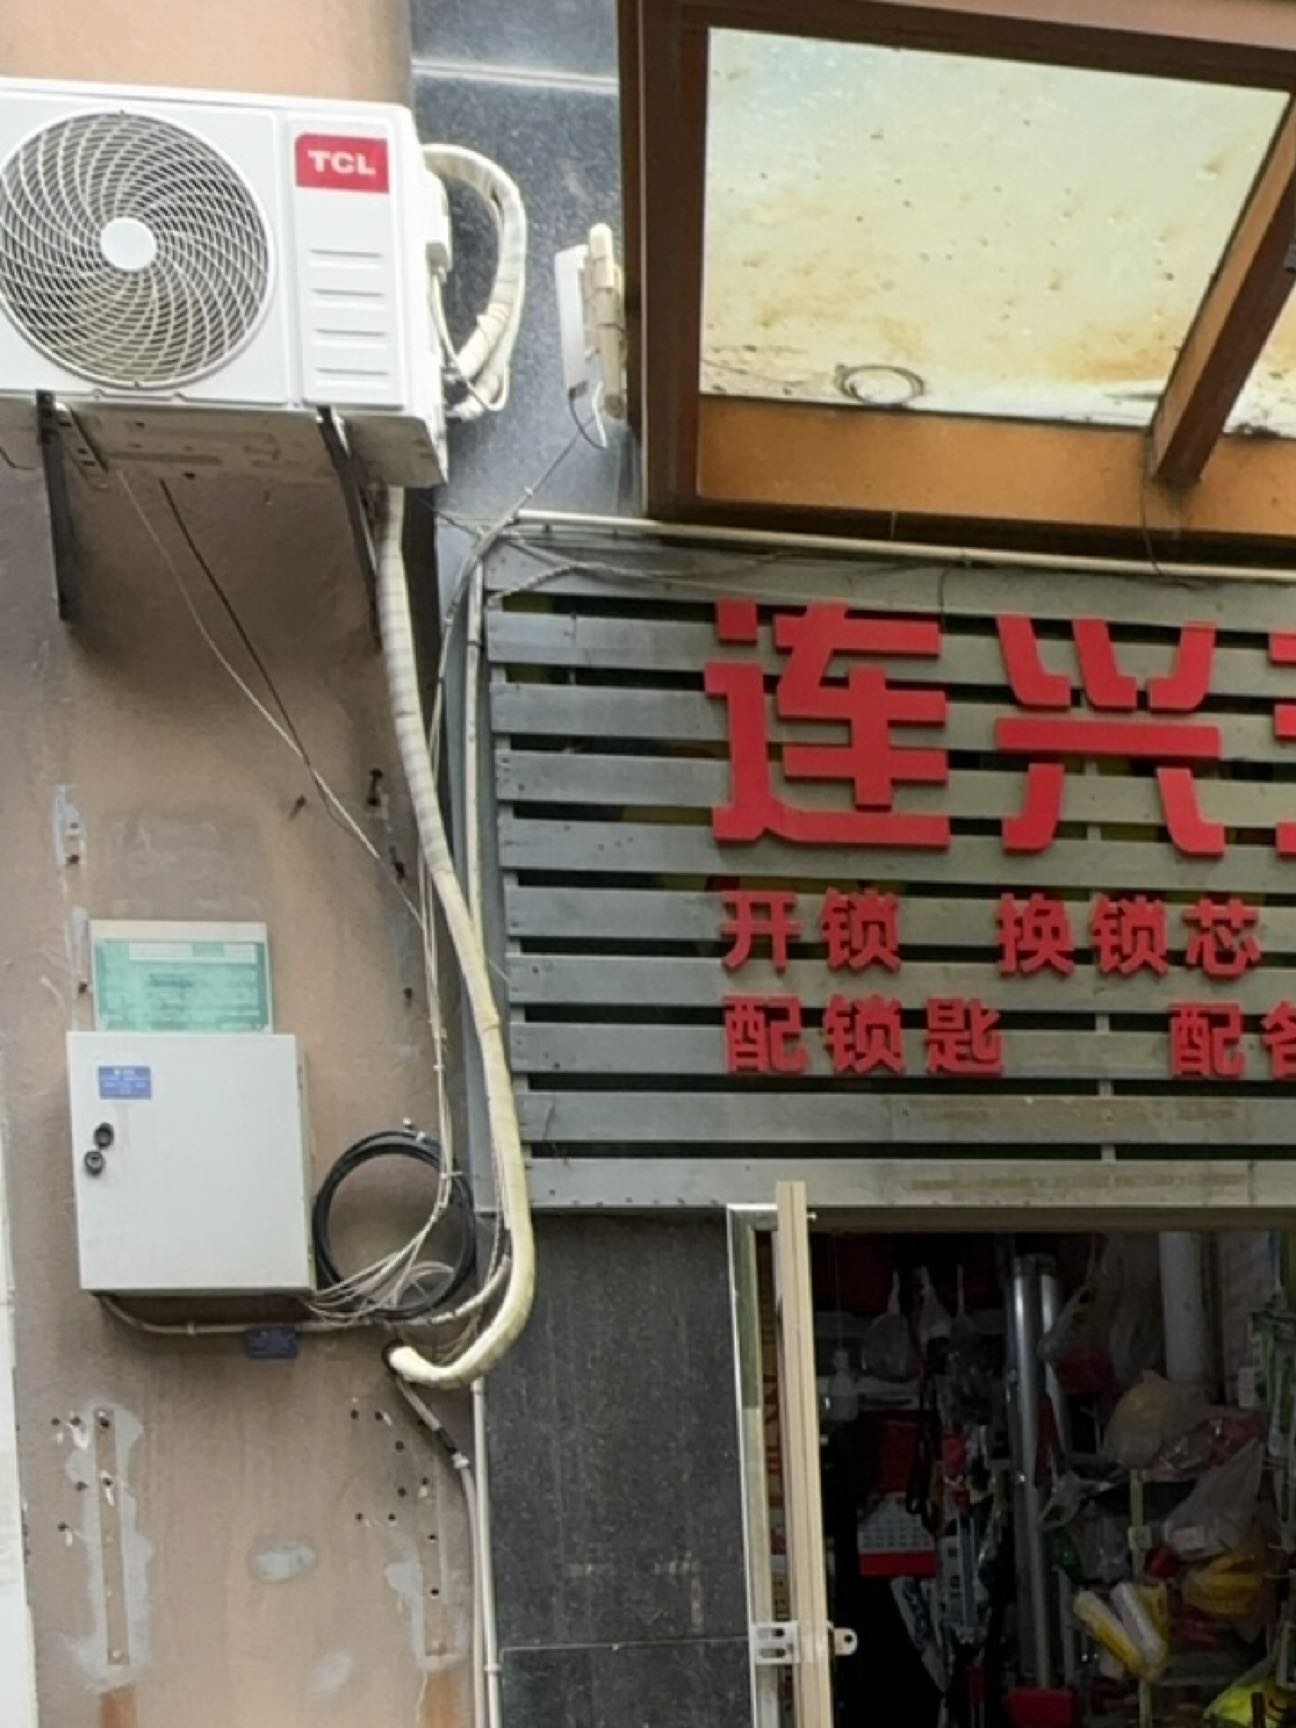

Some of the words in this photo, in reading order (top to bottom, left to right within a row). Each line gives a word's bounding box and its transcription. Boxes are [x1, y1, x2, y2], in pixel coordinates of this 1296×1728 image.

[307, 148, 376, 178] TCL
[720, 887, 901, 974] 开锁
[996, 890, 1262, 980] 换锁芯
[723, 993, 1005, 1077] 配锁匙
